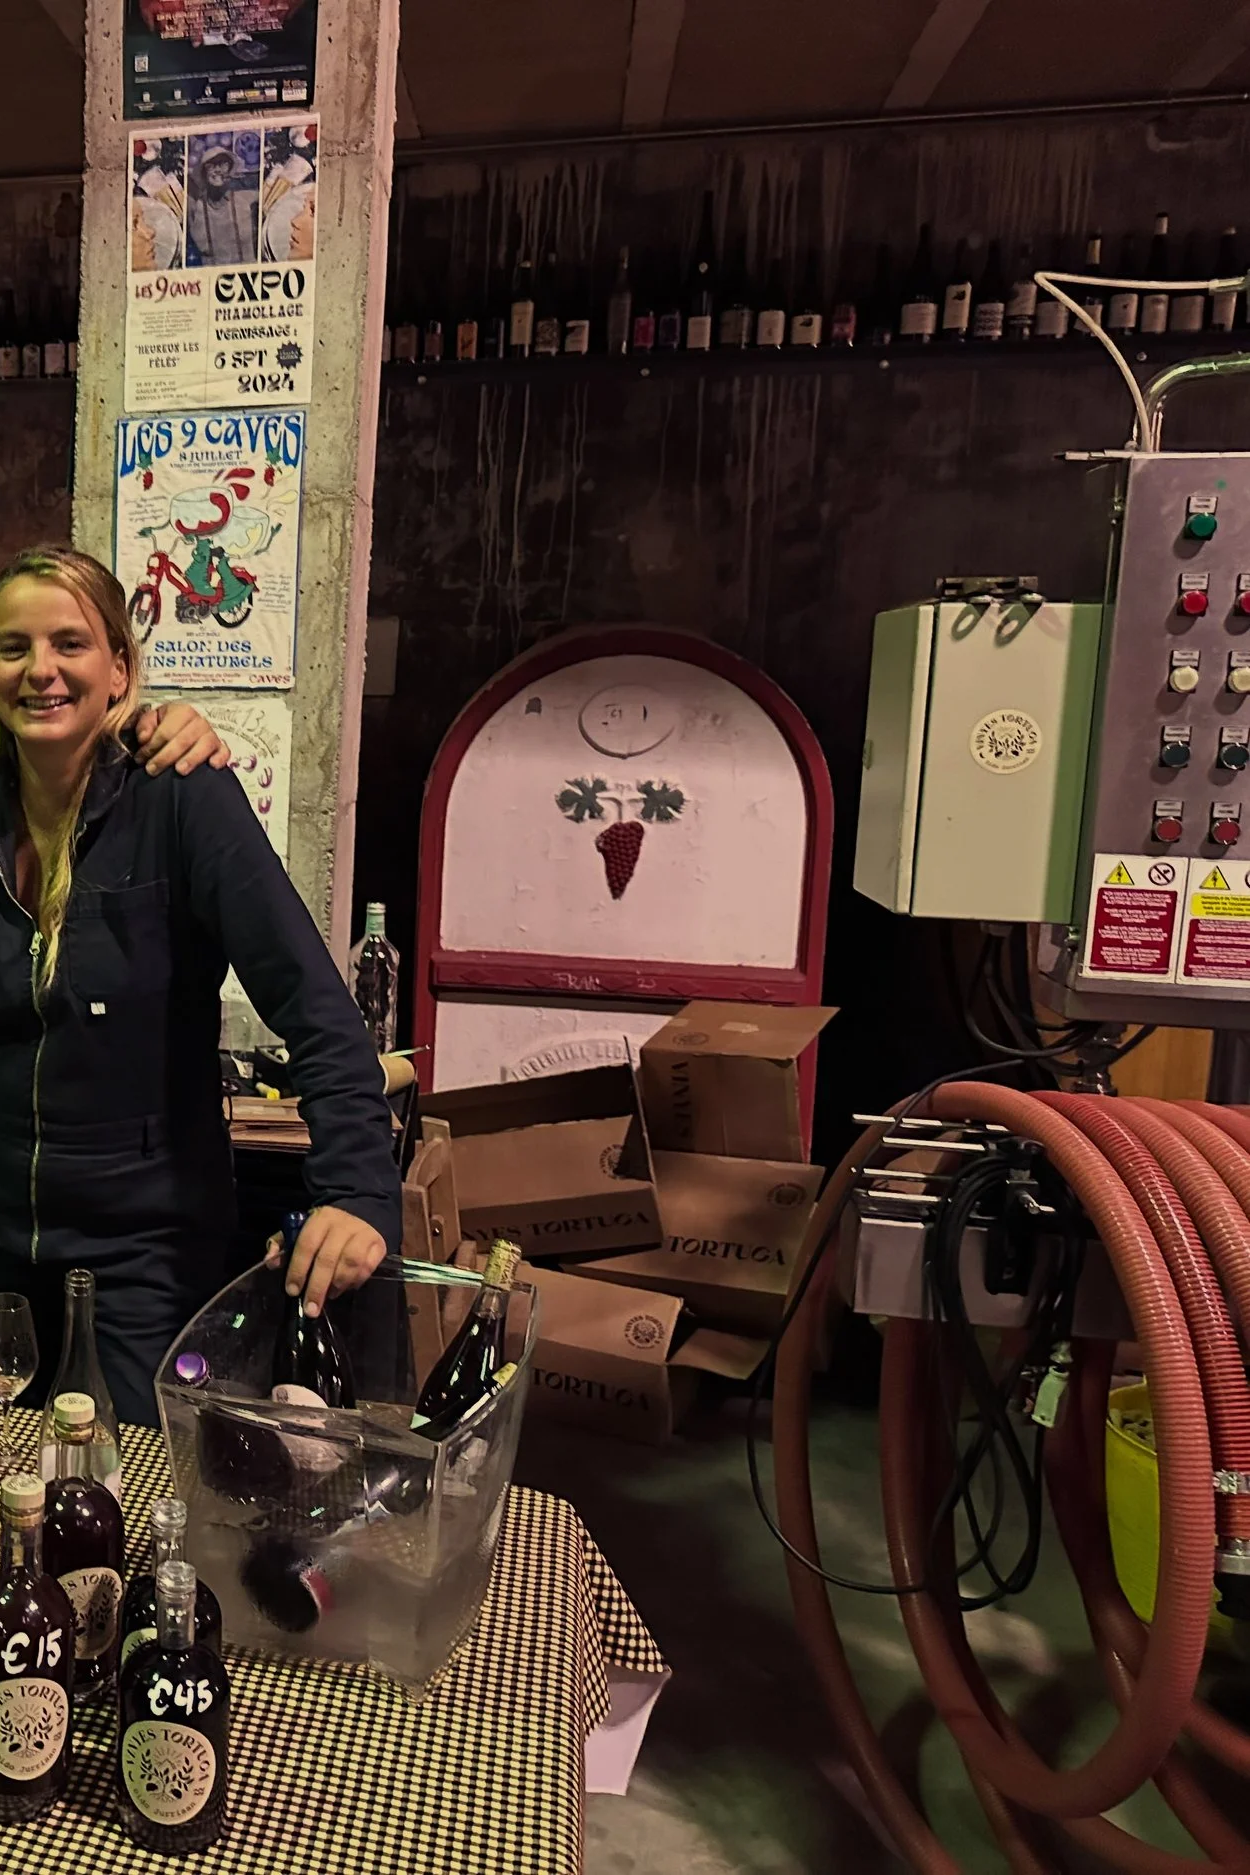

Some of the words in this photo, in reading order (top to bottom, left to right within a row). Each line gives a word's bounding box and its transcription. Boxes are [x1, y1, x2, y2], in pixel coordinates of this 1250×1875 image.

[214, 268, 305, 304] EXPO
[237, 371, 294, 394] 2024
[120, 421, 173, 479] LES
[180, 419, 197, 449] 9
[205, 414, 302, 469] CAVES
[146, 655, 177, 669] INS
[526, 1210, 650, 1238] TORTUGA
[667, 1234, 786, 1266] TORTUGA
[532, 1366, 650, 1412] TORTUGA
